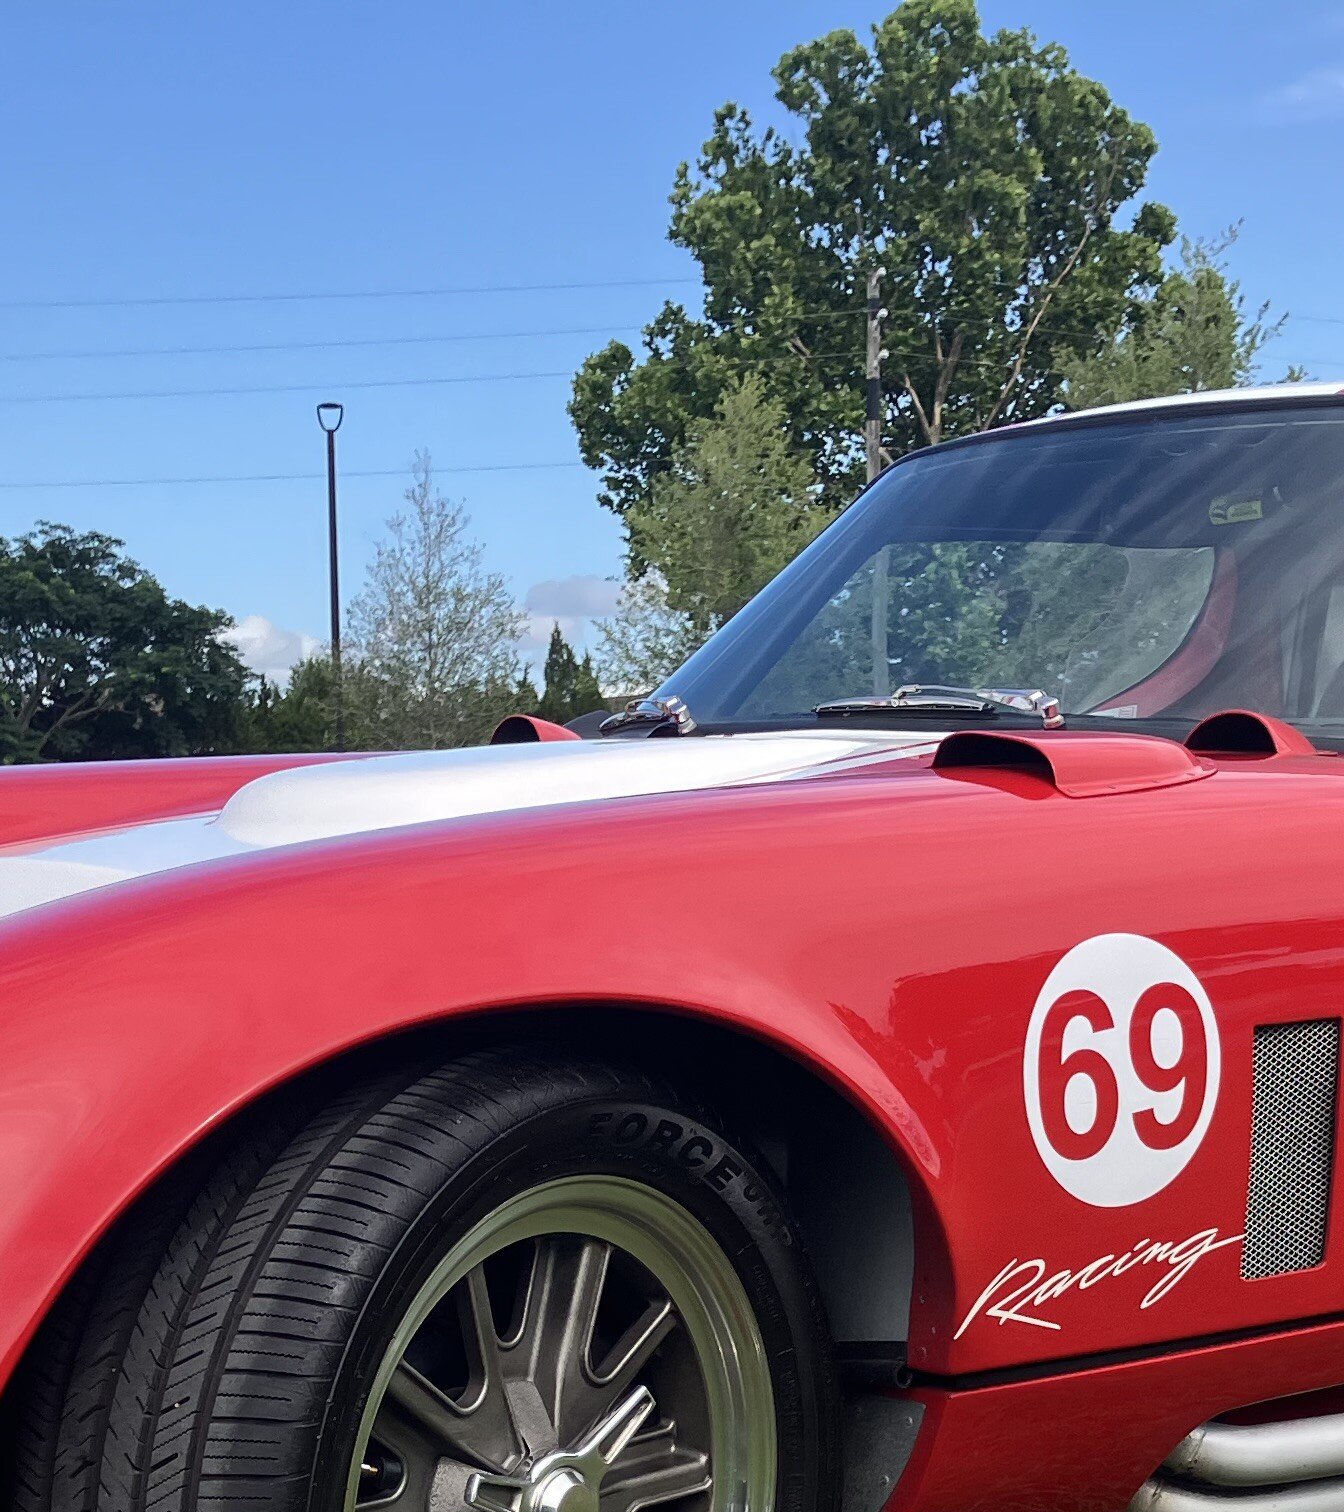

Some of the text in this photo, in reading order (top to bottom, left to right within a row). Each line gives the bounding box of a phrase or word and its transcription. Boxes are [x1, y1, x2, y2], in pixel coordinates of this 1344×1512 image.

[1037, 981, 1209, 1161] 69
[589, 1111, 743, 1192] FORCE
[953, 1226, 1244, 1340] Racing
